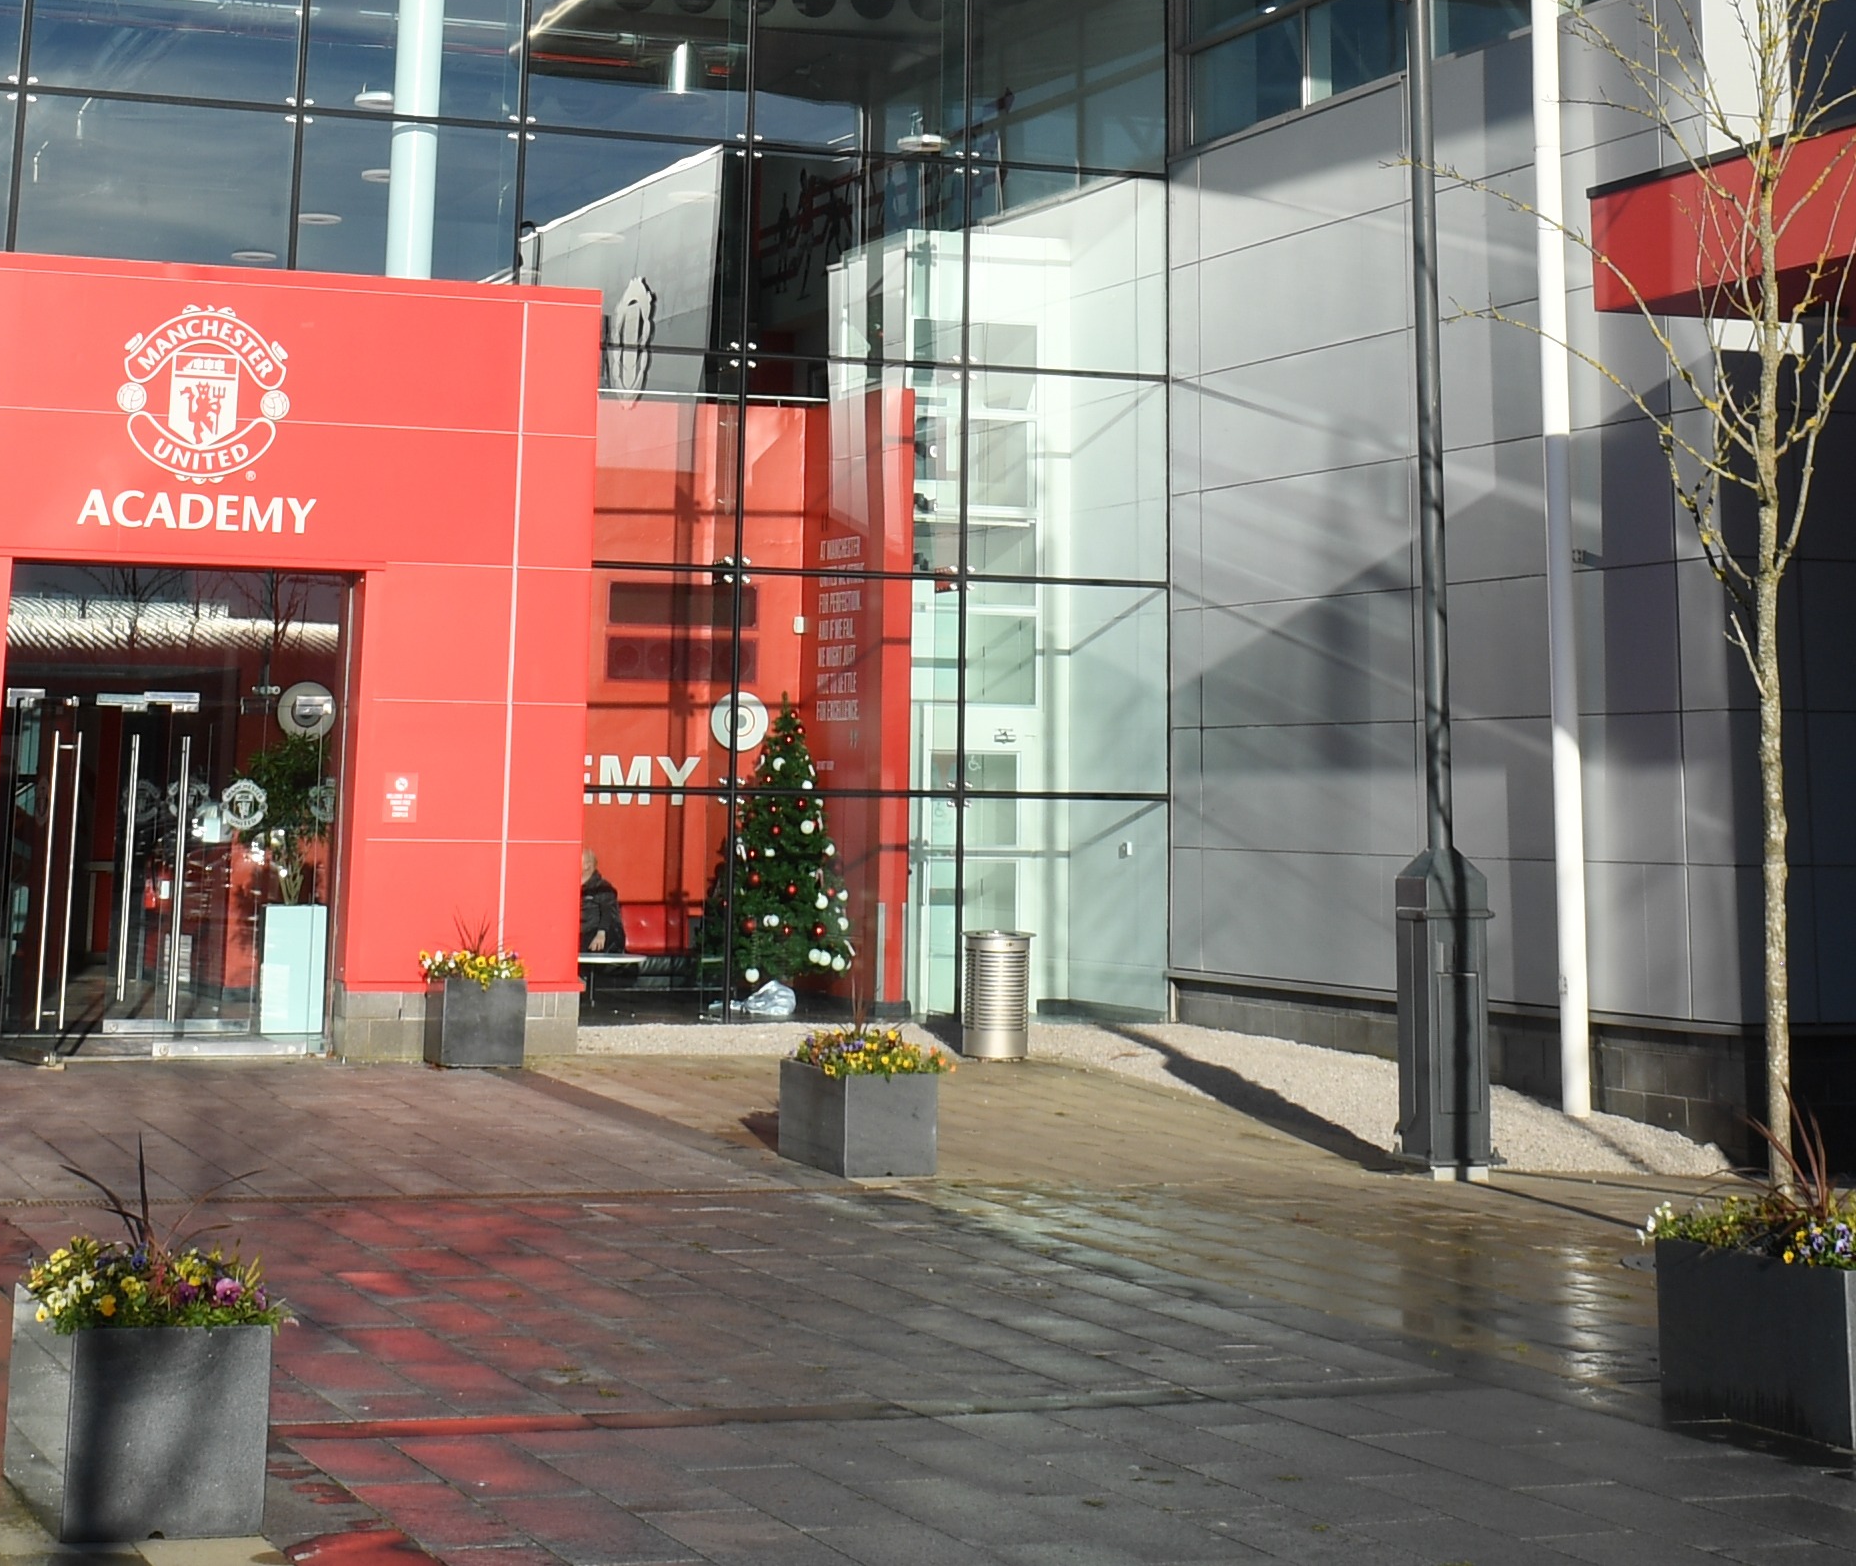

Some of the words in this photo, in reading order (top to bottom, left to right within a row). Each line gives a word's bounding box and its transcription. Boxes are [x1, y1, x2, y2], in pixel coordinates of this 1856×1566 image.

[137, 319, 274, 379] MANCHESTER
[153, 437, 249, 470] UNITED
[76, 489, 317, 535] ACADEMY
